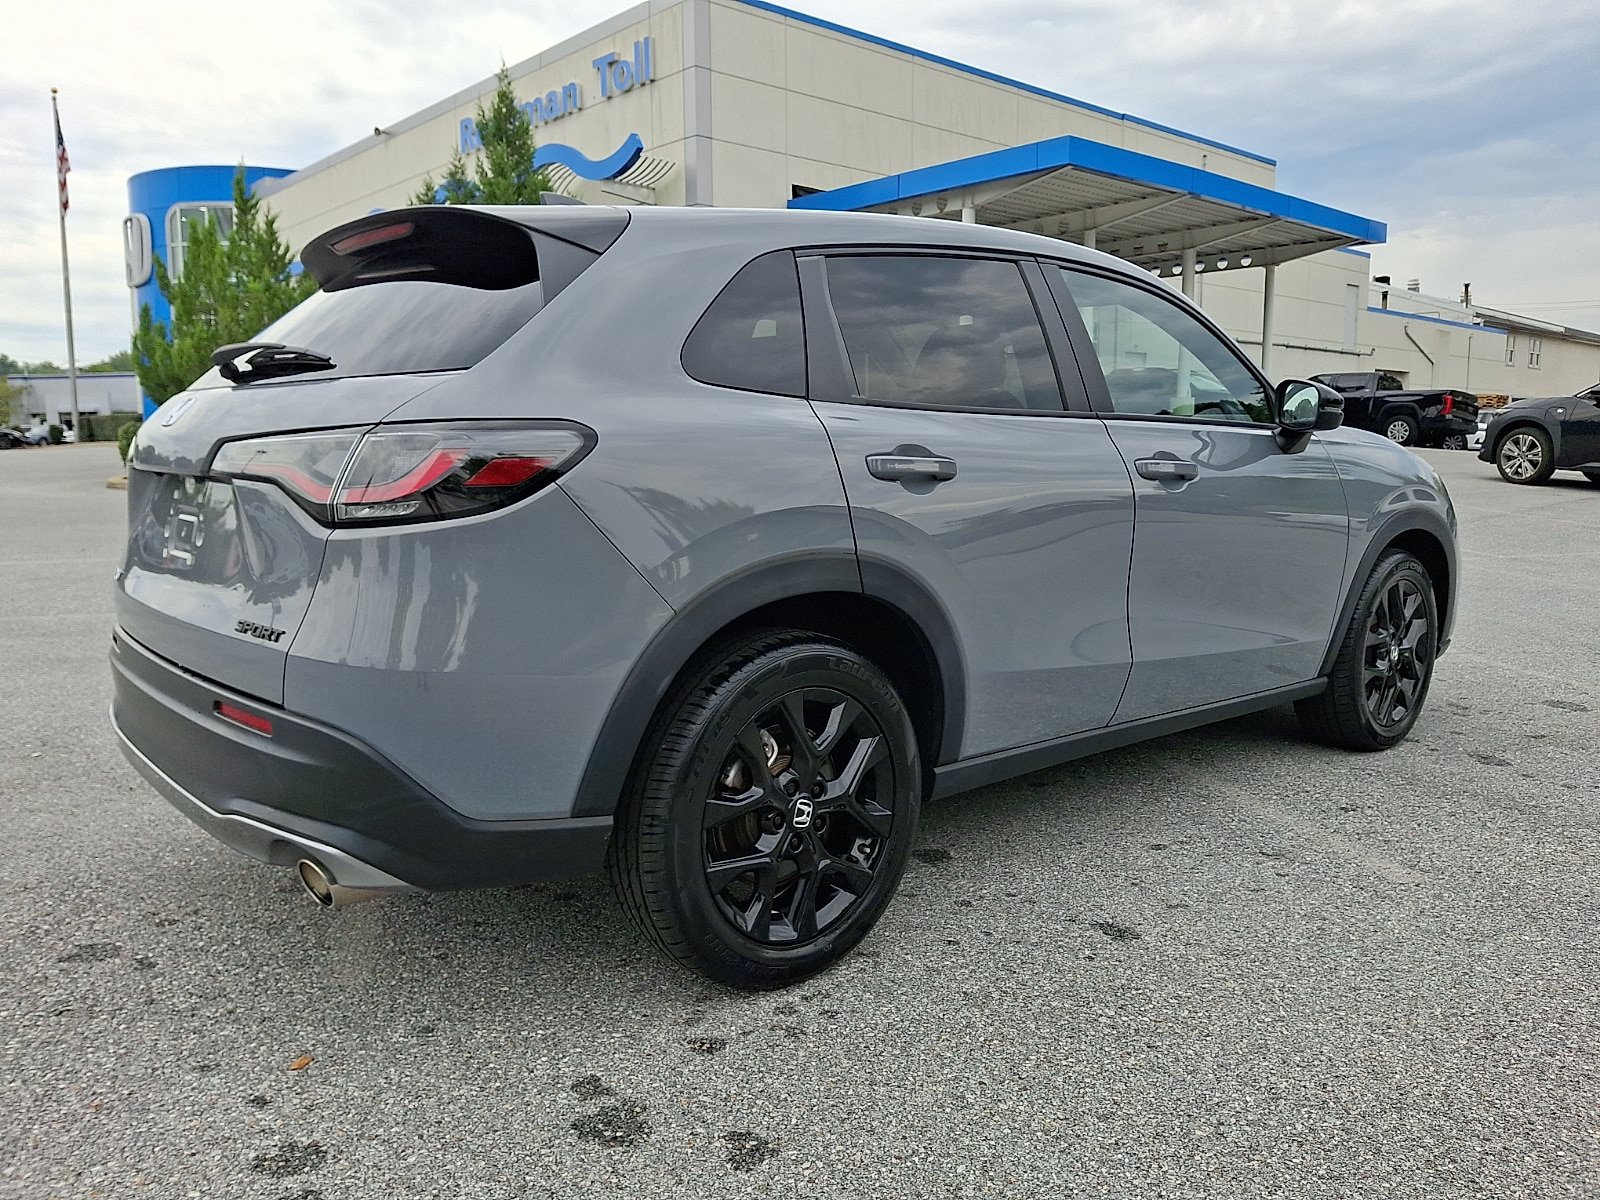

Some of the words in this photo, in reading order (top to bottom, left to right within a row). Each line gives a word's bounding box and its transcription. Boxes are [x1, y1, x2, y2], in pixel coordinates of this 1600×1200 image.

[460, 82, 582, 155] Rman
[592, 36, 654, 99] Toll
[234, 619, 286, 643] SPORT
